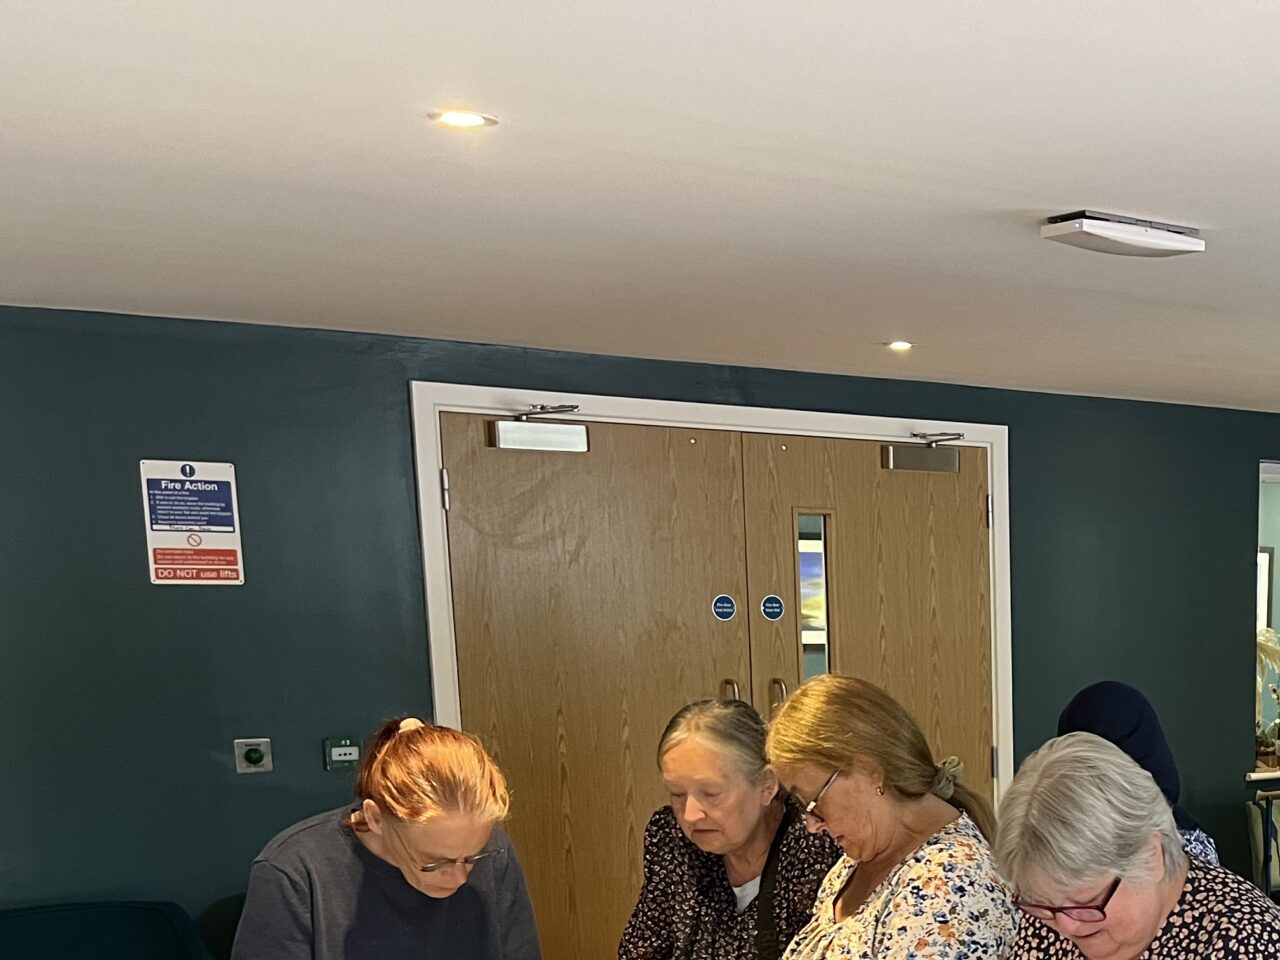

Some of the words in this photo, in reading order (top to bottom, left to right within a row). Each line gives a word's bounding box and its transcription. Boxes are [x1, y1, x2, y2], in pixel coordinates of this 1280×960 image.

[161, 480, 182, 490] Fire
[184, 481, 218, 491] Action
[158, 569, 174, 578] DO
[176, 569, 198, 578] NOT
[219, 569, 237, 579] lifts
